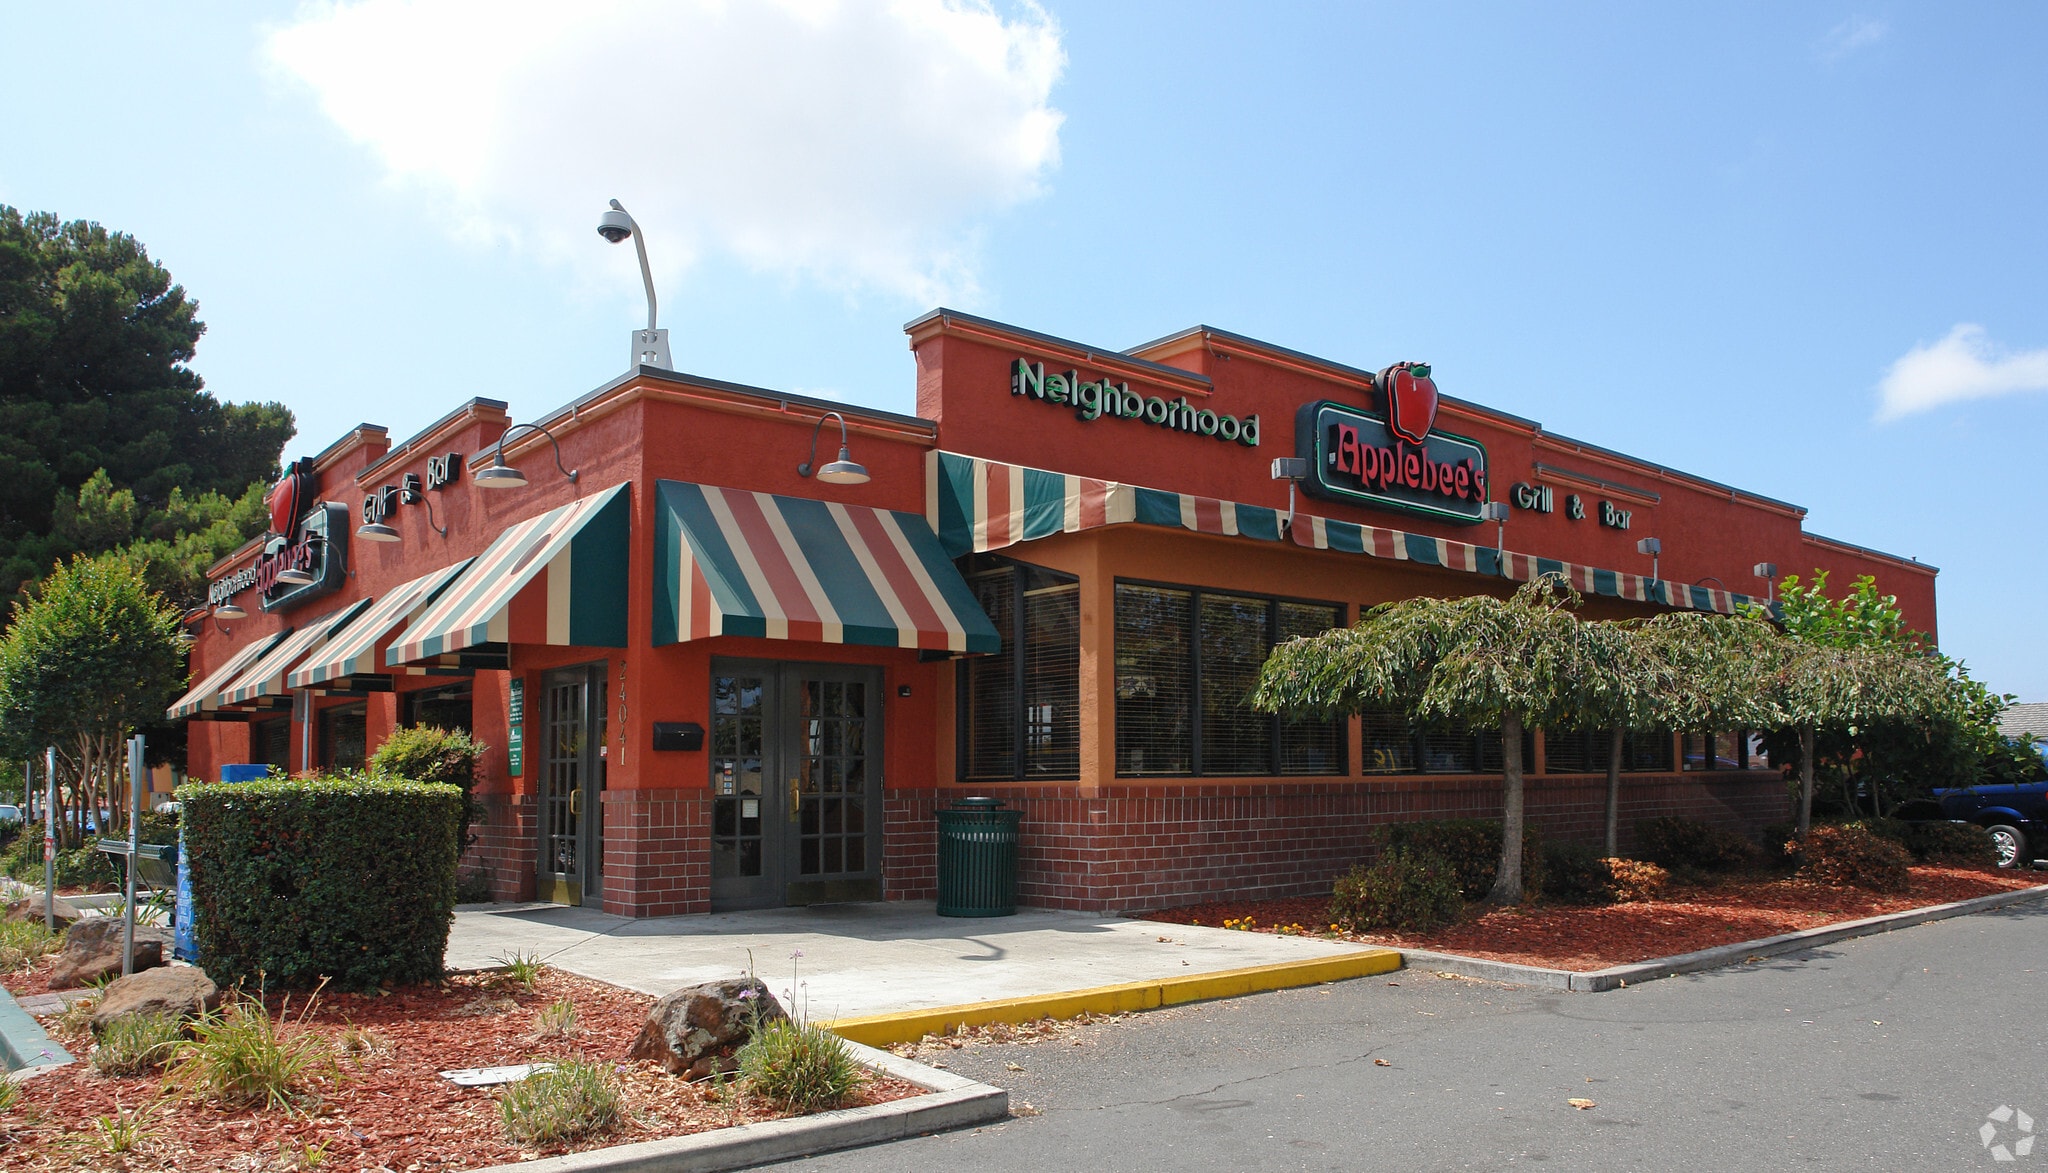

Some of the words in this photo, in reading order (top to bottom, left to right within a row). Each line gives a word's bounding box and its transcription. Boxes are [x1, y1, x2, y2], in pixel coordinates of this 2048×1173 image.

[1014, 357, 1260, 447] Neighborhood
[427, 453, 456, 491] Bar
[1335, 422, 1487, 503] Applebee's
[1512, 481, 1554, 513] Grill
[1569, 494, 1587, 520] &
[1602, 500, 1633, 530] Bar
[618, 660, 628, 767] 24041
